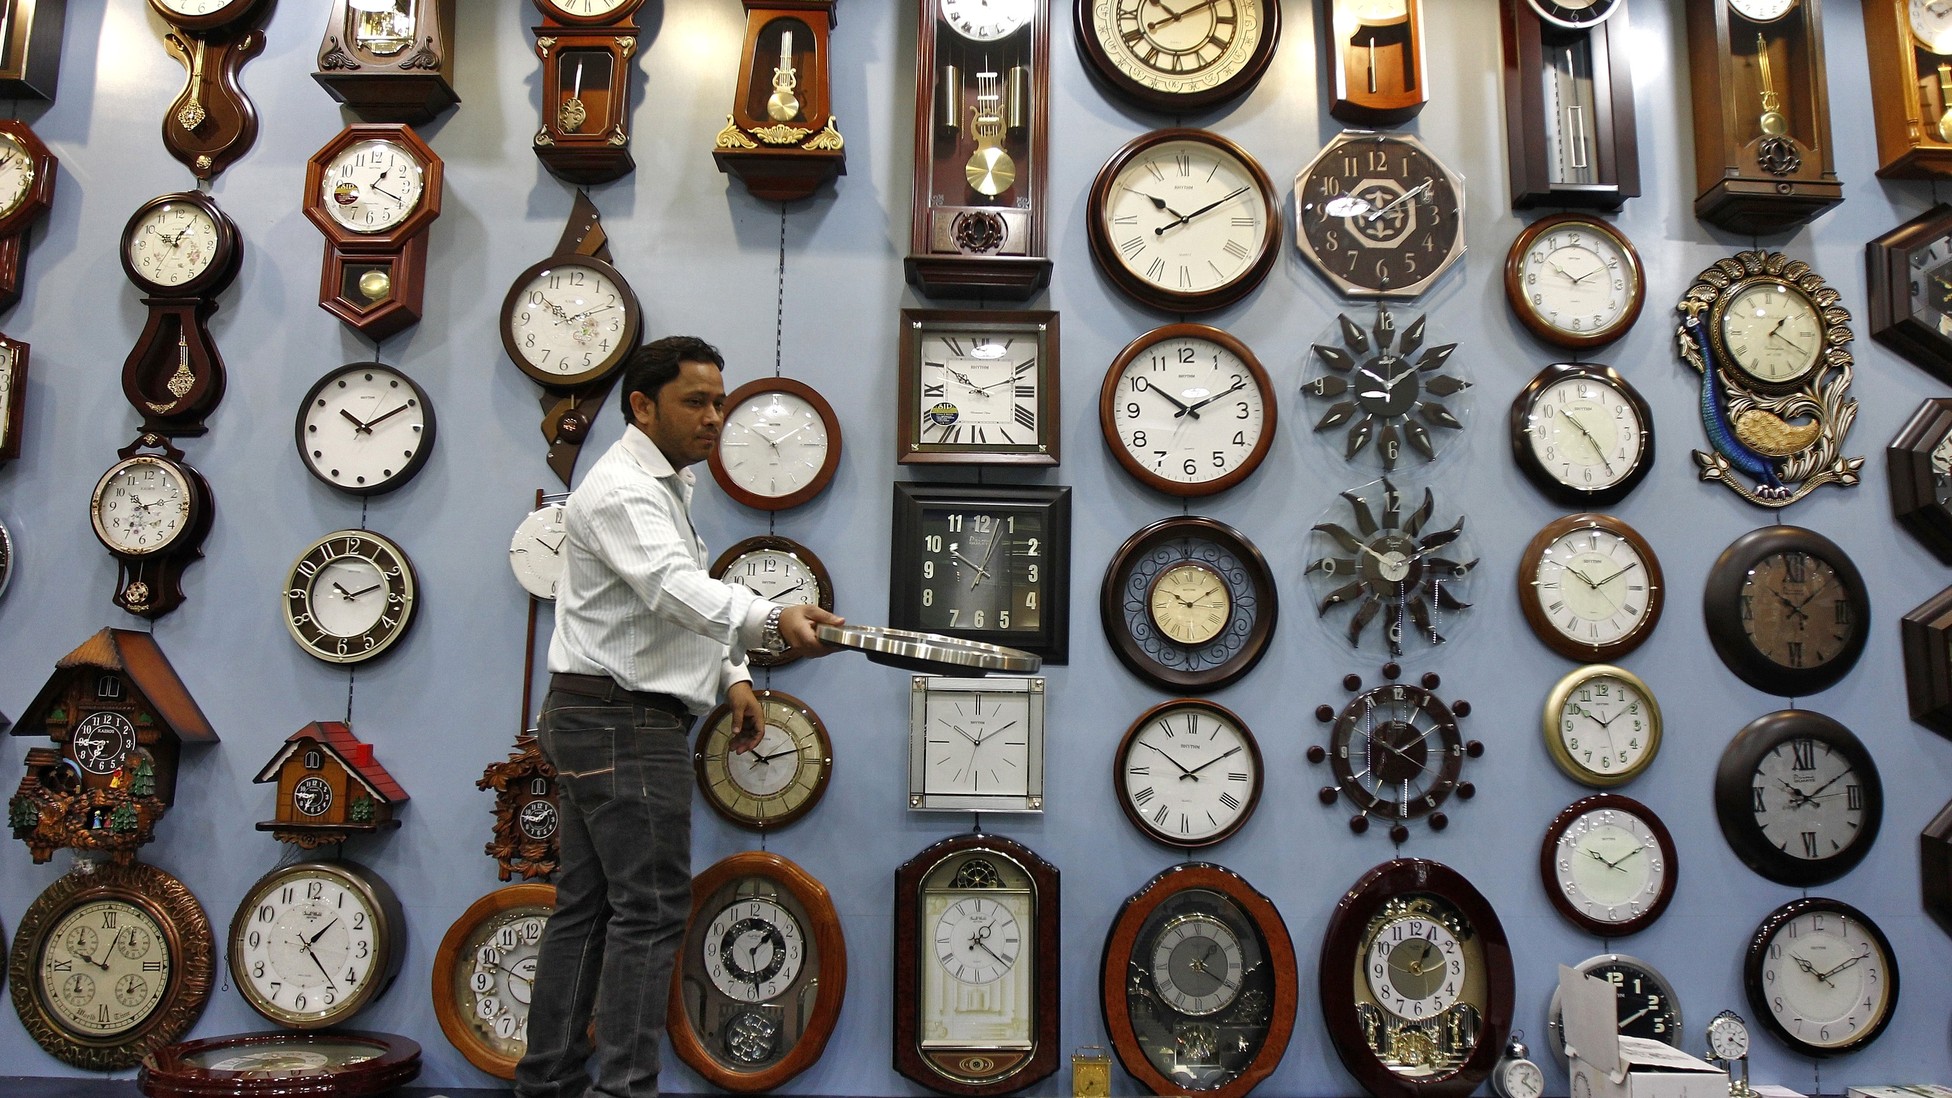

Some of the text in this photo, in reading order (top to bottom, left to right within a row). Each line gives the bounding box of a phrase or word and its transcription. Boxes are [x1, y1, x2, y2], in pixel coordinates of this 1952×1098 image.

[356, 154, 365, 167] 11
[371, 151, 383, 163] 12
[1369, 151, 1388, 171] 12
[341, 164, 353, 178] 10
[1344, 157, 1358, 177] 11
[1403, 158, 1409, 177] 1
[1323, 176, 1339, 196] 10
[158, 215, 165, 223] 11
[175, 209, 185, 219] 12
[350, 206, 358, 220] 7
[1430, 206, 1440, 225] 3
[145, 225, 155, 234] 10
[1326, 231, 1338, 250] 8
[1423, 232, 1434, 252] 4
[1347, 251, 1358, 271] 7
[1376, 259, 1388, 278] 6
[1405, 253, 1416, 273] 5
[549, 276, 560, 289] 11
[569, 272, 584, 286] 12
[595, 280, 600, 293] 1
[528, 291, 544, 305] 10
[606, 294, 615, 309] 2
[520, 312, 530, 326] 9
[610, 317, 619, 331] 3
[1380, 312, 1395, 330] 12
[526, 334, 535, 348] 8
[598, 338, 609, 352] 4
[541, 349, 550, 363] 7
[582, 353, 592, 366] 5
[1152, 356, 1166, 371] 11
[1178, 348, 1195, 364] 12
[1213, 355, 1218, 370] 1
[559, 357, 568, 371] 6
[1130, 377, 1148, 392] 10
[1231, 374, 1243, 390] 2
[1315, 377, 1324, 395] 9
[1127, 403, 1140, 418] 9
[1236, 402, 1249, 419] 3
[1544, 404, 1553, 418] 10
[1133, 431, 1147, 447] 8
[1232, 431, 1245, 447] 4
[1539, 425, 1546, 439] 9
[1388, 441, 1397, 459] 6
[1154, 451, 1167, 467] 7
[1213, 451, 1225, 467] 5
[1183, 459, 1196, 475] 6
[144, 471, 154, 480] 12
[1584, 468, 1592, 482] 6
[116, 488, 125, 496] 10
[110, 502, 117, 511] 9
[113, 517, 120, 528] 8
[948, 514, 962, 532] 11
[974, 515, 990, 533] 12
[1007, 516, 1014, 533] 1
[139, 534, 146, 544] 6
[345, 537, 360, 555] 12
[925, 535, 942, 553] 10
[320, 543, 335, 560] 11
[1028, 538, 1038, 556] 2
[297, 560, 316, 578] 10
[383, 565, 400, 580] 2
[747, 563, 756, 576] 11
[762, 559, 776, 572] 12
[785, 565, 789, 577] 1
[924, 561, 934, 579] 9
[1028, 565, 1038, 582] 3
[923, 589, 932, 606] 8
[1026, 592, 1036, 610] 4
[293, 612, 310, 626] 8
[950, 610, 959, 627] 7
[974, 610, 984, 628] 6
[1000, 611, 1009, 629] 5
[337, 638, 348, 655] 6
[1595, 684, 1608, 697] 12
[1618, 689, 1625, 701] 1
[103, 715, 112, 724] 12
[83, 725, 91, 734] 10
[123, 726, 128, 734] 2
[126, 740, 131, 748] 3
[1630, 738, 1638, 749] 4
[1585, 750, 1592, 763] 7
[1792, 739, 1816, 771] XII
[99, 761, 104, 770] 6
[1754, 787, 1766, 812] IX
[1846, 785, 1862, 810] III
[1801, 832, 1818, 858] VI
[282, 888, 293, 904] 11
[307, 882, 322, 899] 12
[338, 892, 343, 908] 1
[259, 906, 274, 923] 10
[731, 908, 738, 921] 11
[750, 904, 760, 916] 12
[353, 912, 364, 930] 2
[1812, 915, 1824, 931] 12
[526, 924, 538, 939] 12
[713, 923, 724, 936] 10
[1393, 927, 1402, 941] 11
[1410, 922, 1422, 936] 12
[249, 931, 260, 950] 9
[503, 930, 512, 945] 11
[356, 941, 367, 958] 3
[483, 949, 495, 964] 10
[708, 943, 716, 957] 9
[790, 946, 798, 959] 3
[253, 961, 264, 978] 8
[1374, 964, 1383, 978] 9
[1451, 961, 1460, 975] 3
[345, 967, 356, 985] 4
[477, 974, 486, 990] 9
[1607, 972, 1624, 987] 12
[1766, 970, 1775, 985] 9
[1870, 969, 1876, 984] 3
[271, 982, 281, 1000] 7
[1633, 979, 1641, 993] 1
[295, 993, 306, 1010] 6
[324, 986, 335, 1004] 5
[1648, 995, 1659, 1010] 2
[484, 1000, 492, 1015] 8
[1396, 999, 1405, 1013] 7
[1414, 1002, 1422, 1016] 6
[502, 1019, 510, 1033] 7
[1820, 1025, 1829, 1041] 6
